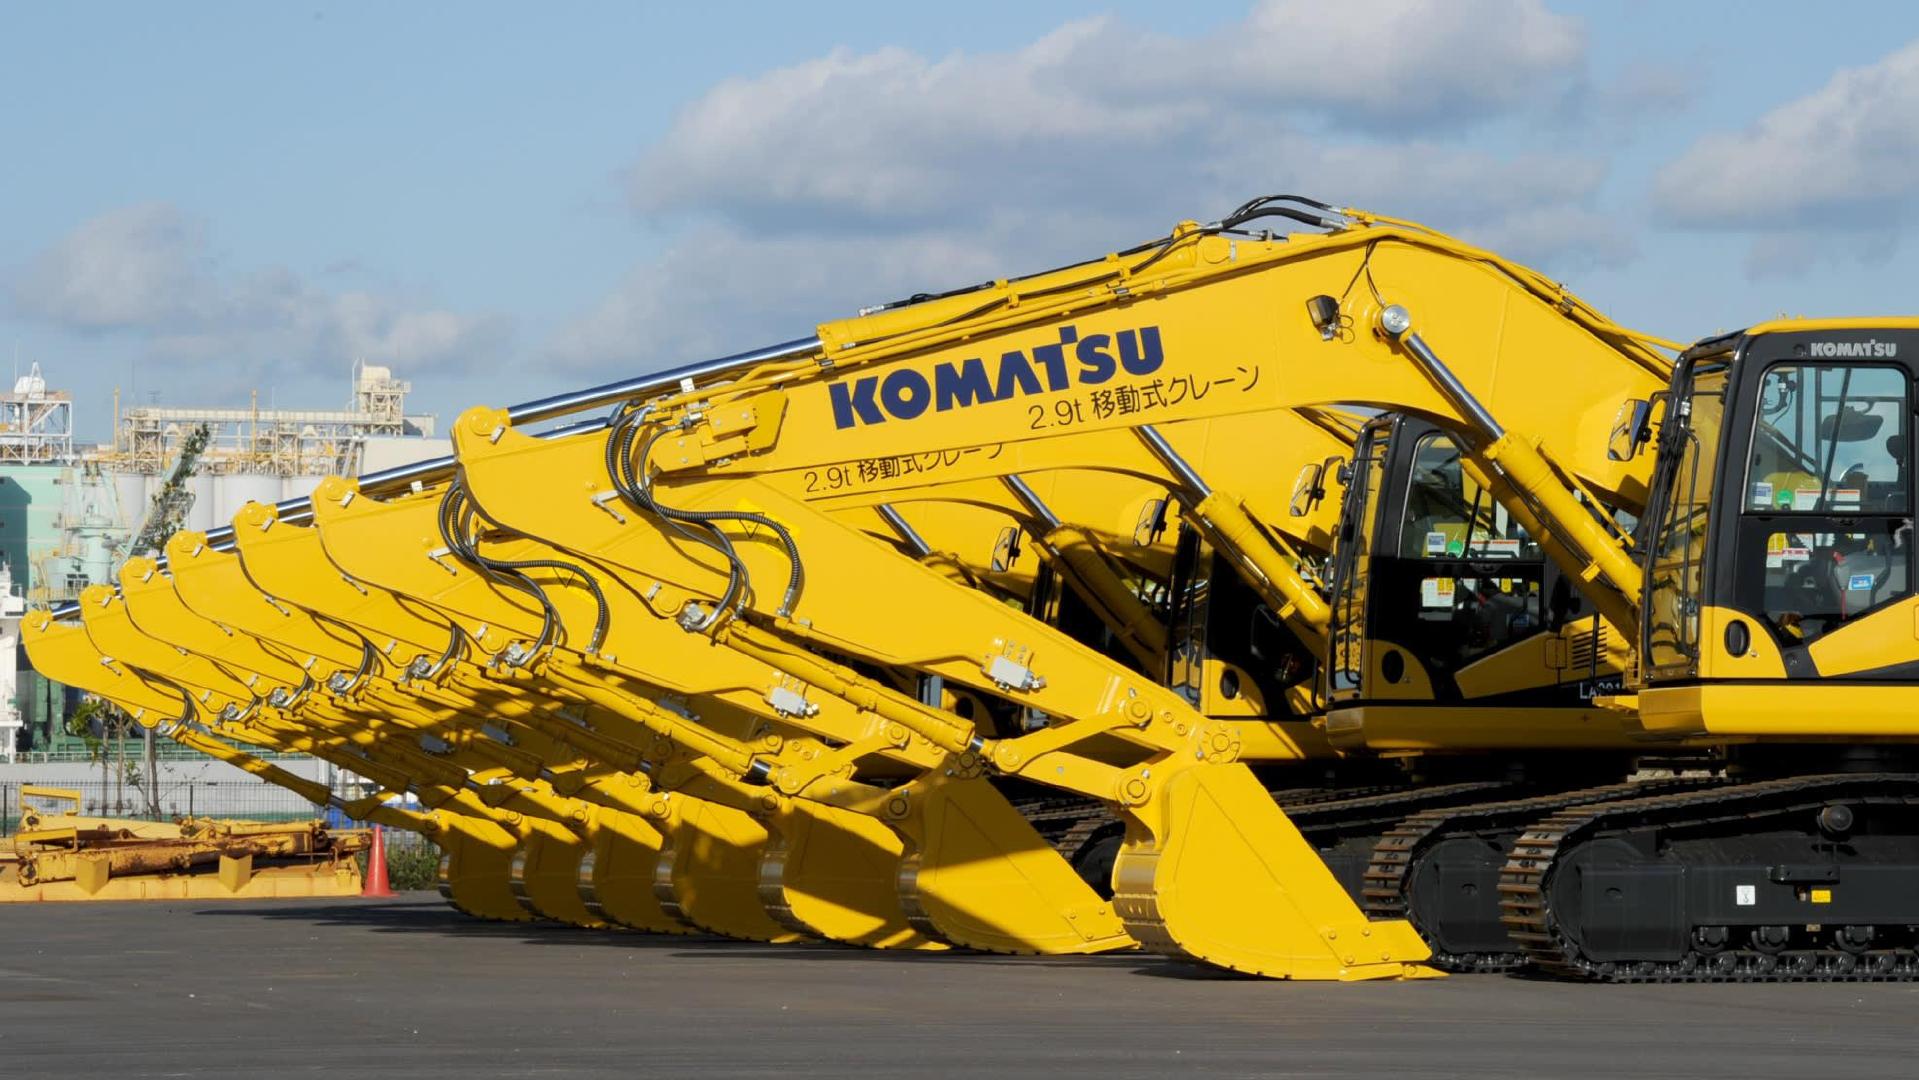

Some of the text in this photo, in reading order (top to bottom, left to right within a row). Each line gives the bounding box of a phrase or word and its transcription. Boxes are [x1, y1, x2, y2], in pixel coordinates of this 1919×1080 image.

[1810, 339, 1897, 357] KOMATSU
[828, 325, 1164, 430] KOMATSU
[1028, 365, 1260, 430] 2.9t 移動式クレーン
[804, 466, 853, 493] 2.9t
